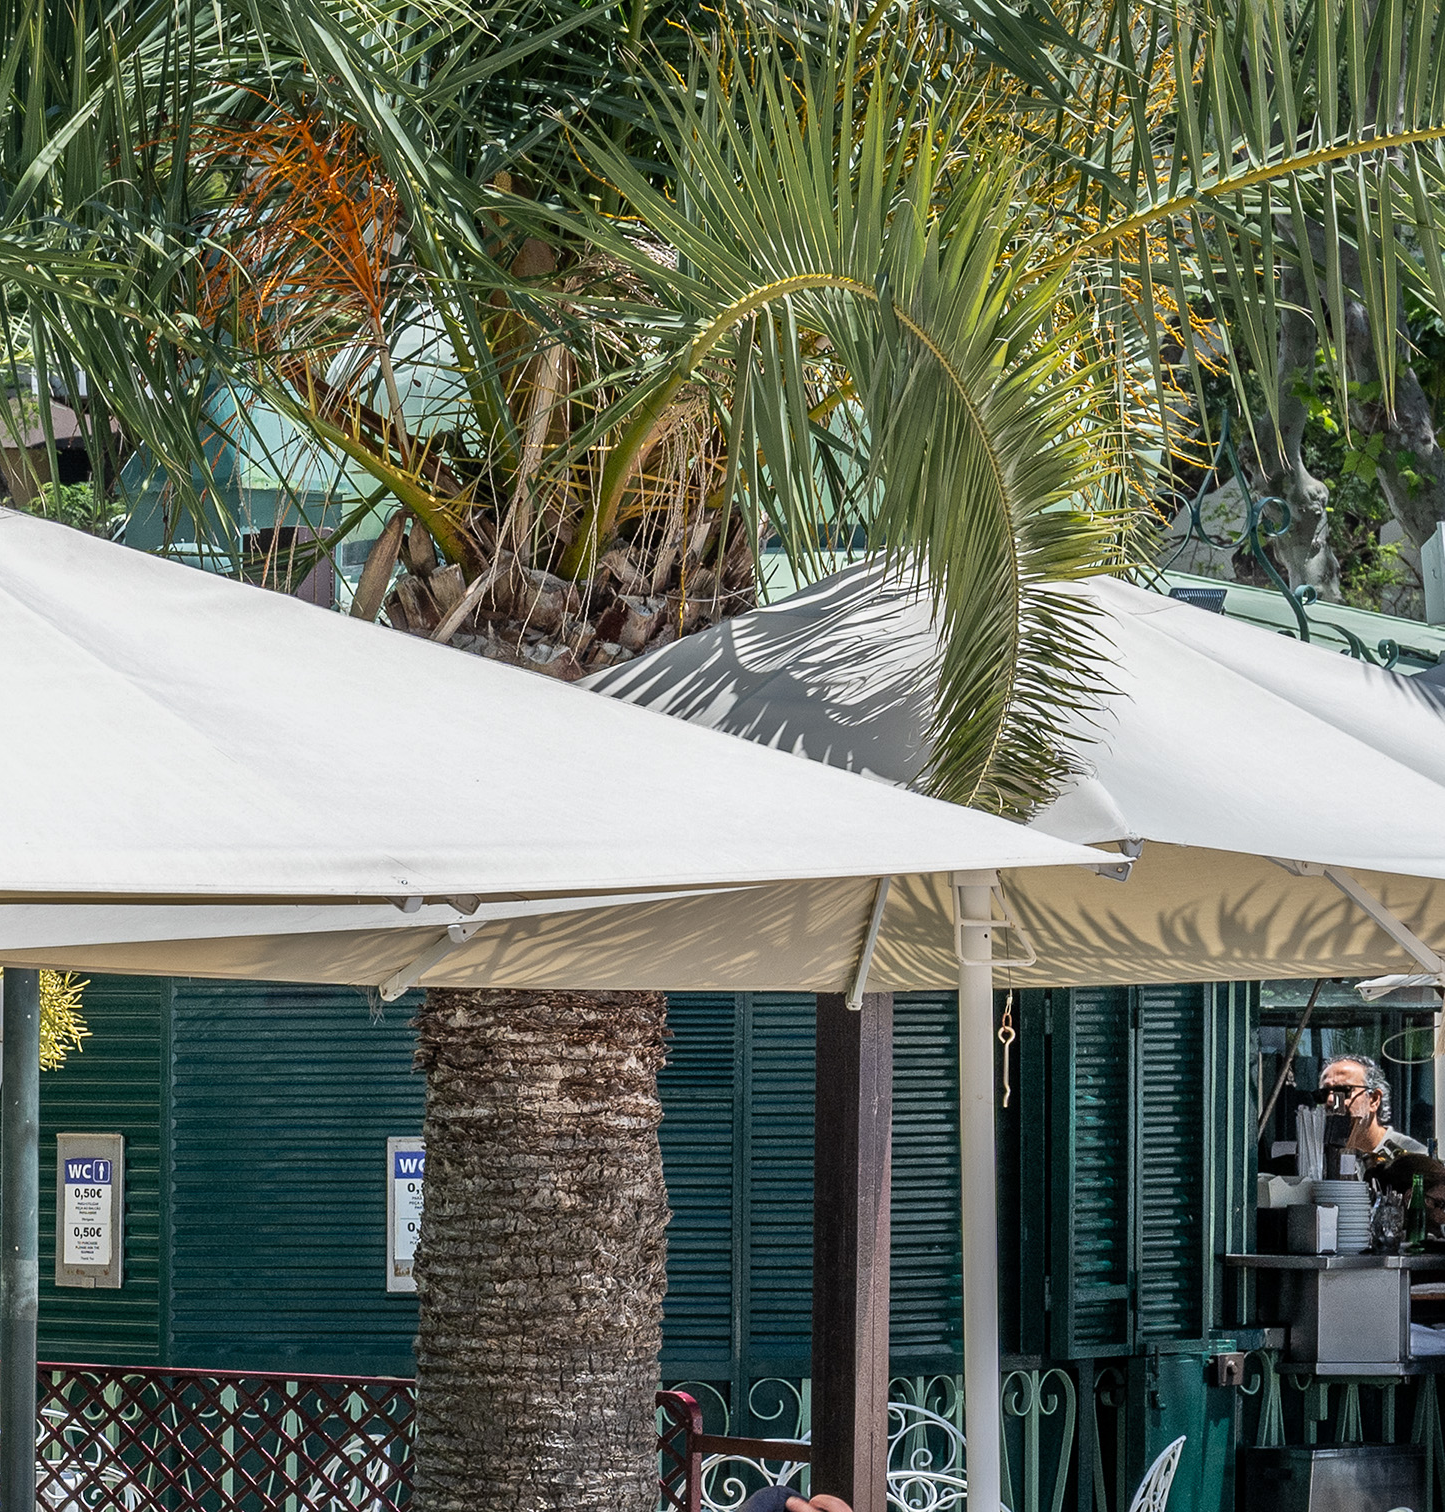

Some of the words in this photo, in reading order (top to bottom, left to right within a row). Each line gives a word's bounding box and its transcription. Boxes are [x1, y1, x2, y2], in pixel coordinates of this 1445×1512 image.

[68, 1164, 92, 1179] WC
[74, 1188, 103, 1200] 0,50€
[74, 1227, 102, 1239] 0,50€
